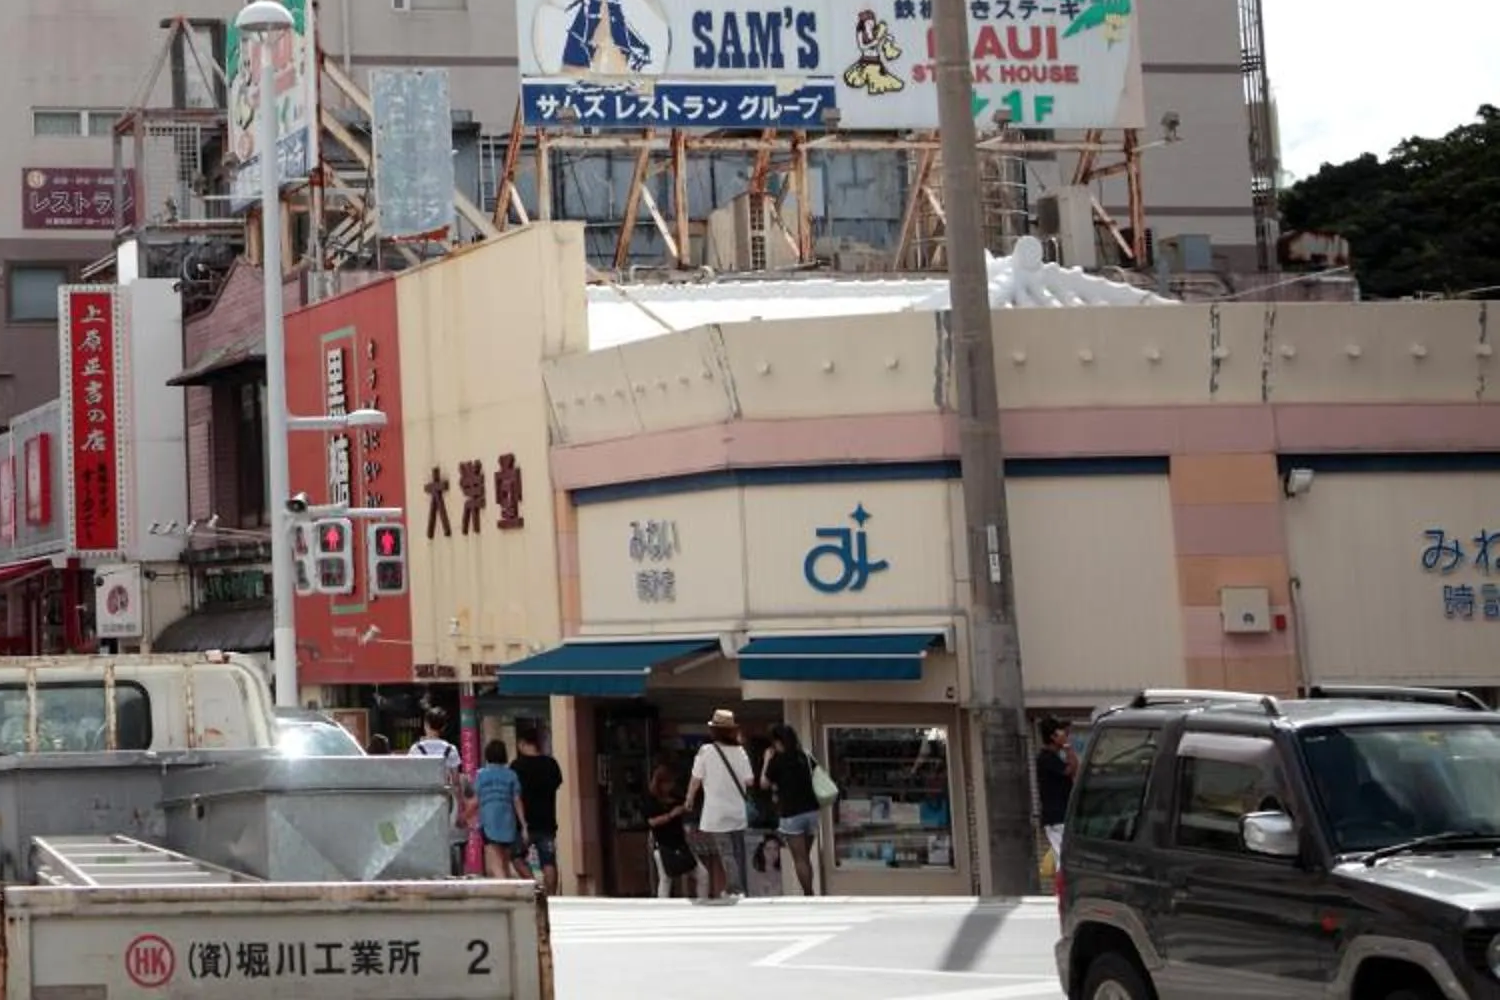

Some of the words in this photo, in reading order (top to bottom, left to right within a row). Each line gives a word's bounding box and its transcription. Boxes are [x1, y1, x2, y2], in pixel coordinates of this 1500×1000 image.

[692, 6, 820, 70] SAM'S
[926, 25, 1059, 61] AUI
[1000, 65, 1079, 83] HOUSE
[614, 95, 728, 121] レストラン
[736, 95, 823, 121] グループ
[424, 452, 524, 540] 大洋堂
[135, 947, 168, 976] HK
[467, 940, 492, 974] 2
